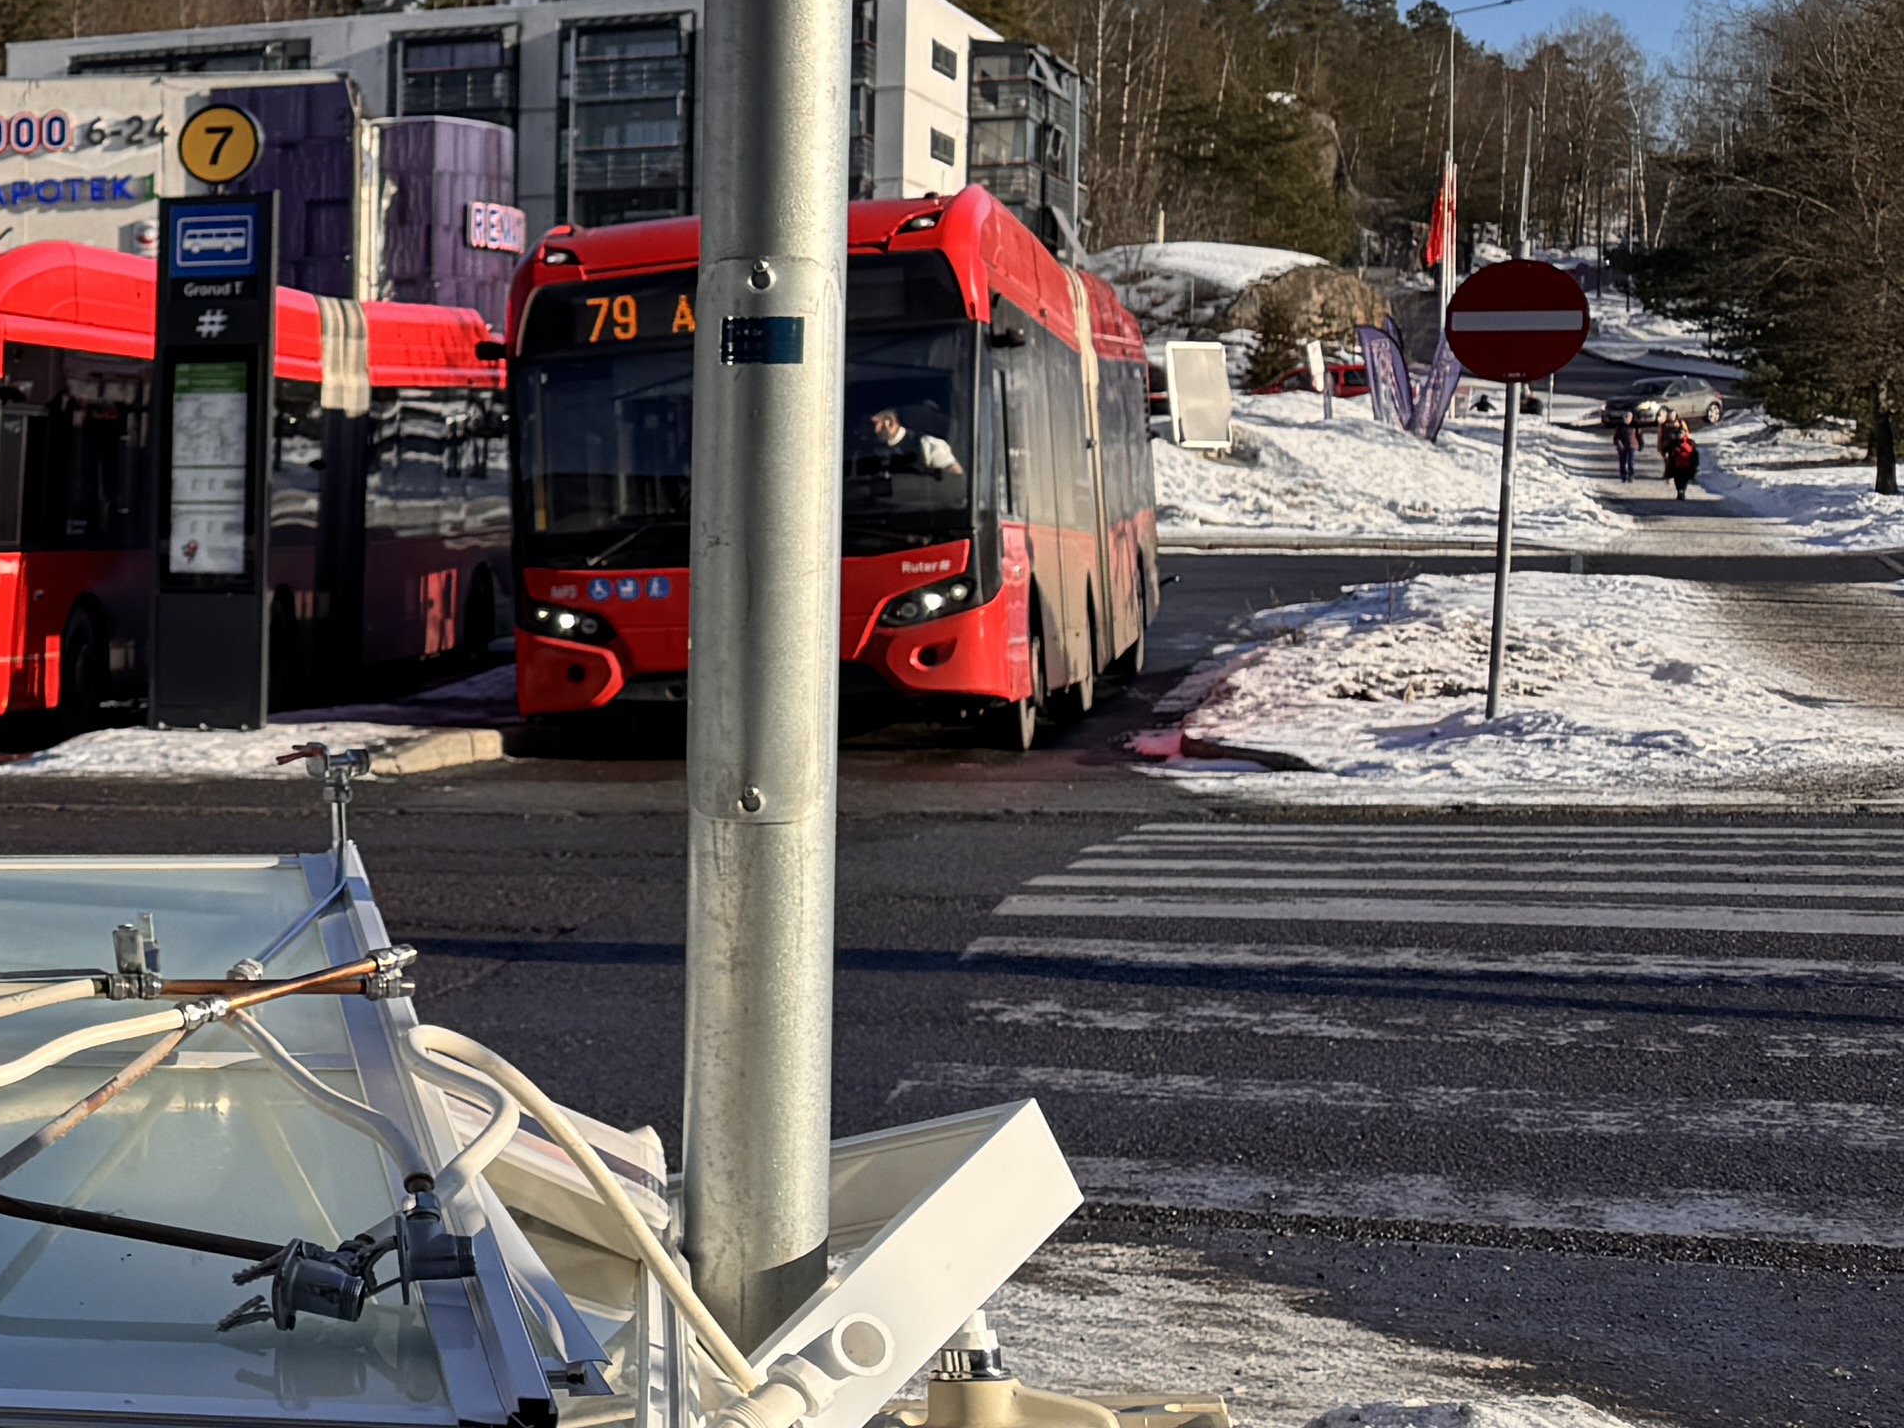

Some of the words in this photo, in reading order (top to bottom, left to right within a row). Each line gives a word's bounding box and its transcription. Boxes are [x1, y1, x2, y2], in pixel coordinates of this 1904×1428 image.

[85, 113, 169, 146] 6-24
[204, 126, 235, 166] 7
[585, 294, 638, 343] 79
